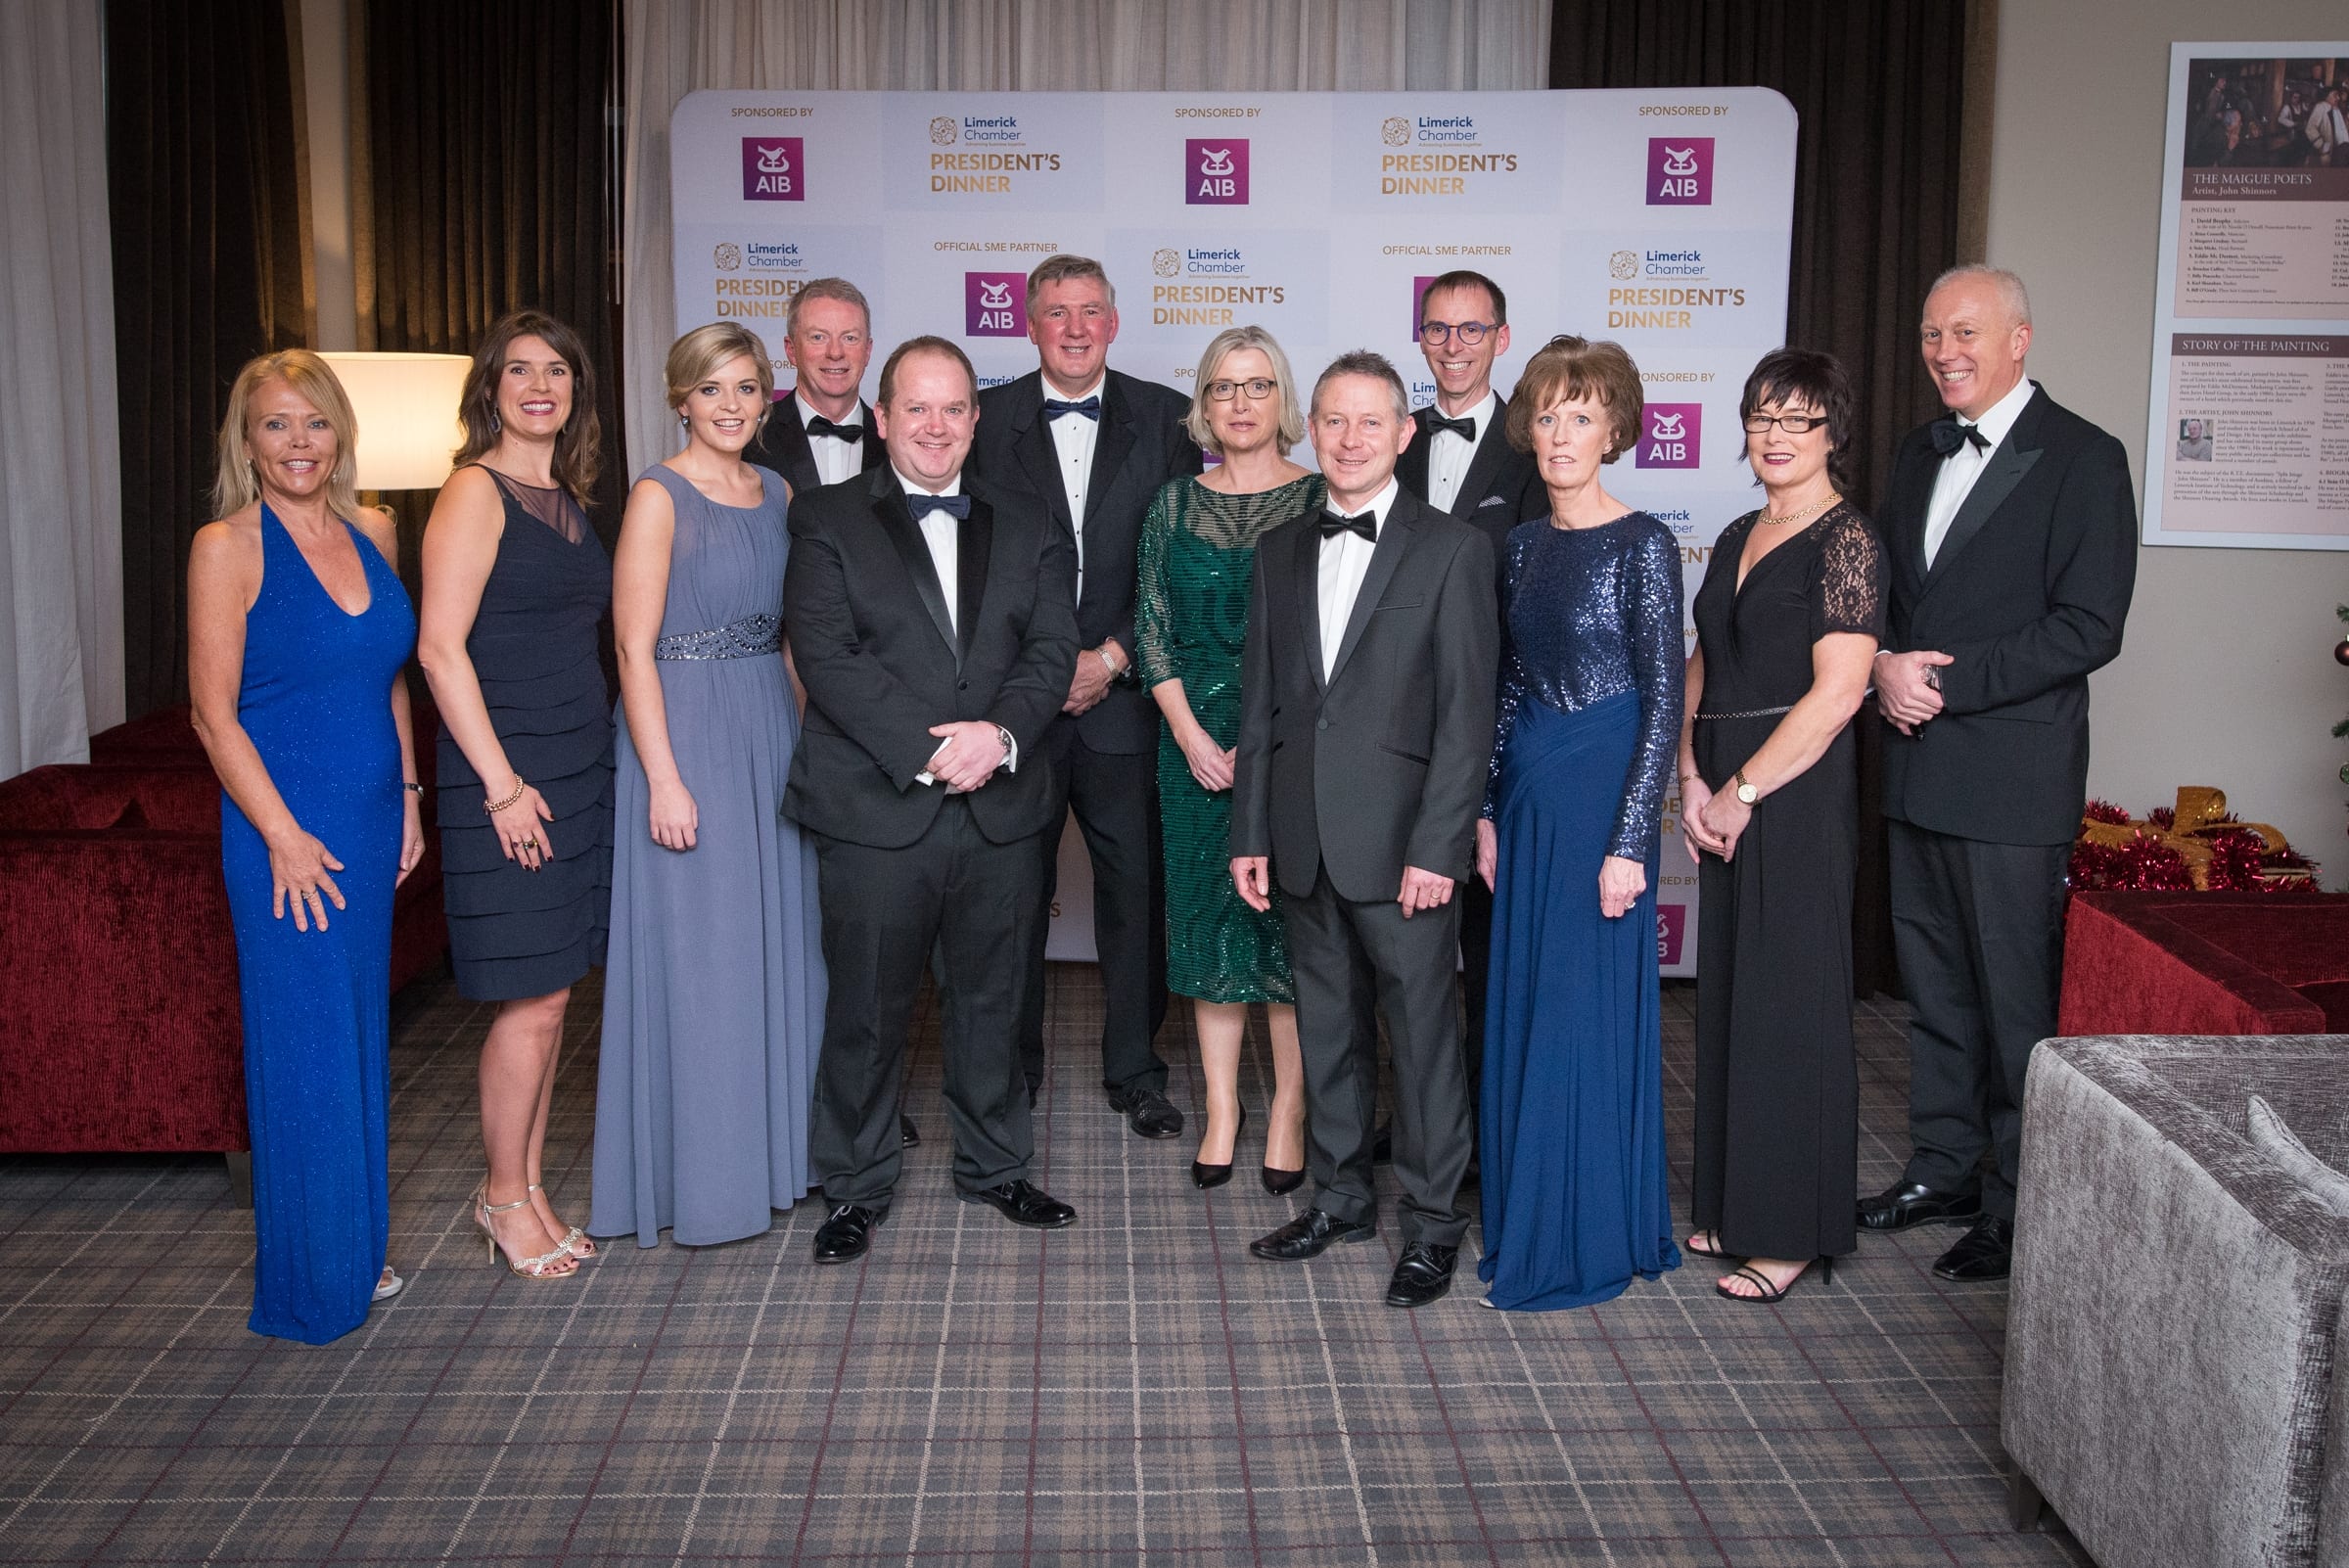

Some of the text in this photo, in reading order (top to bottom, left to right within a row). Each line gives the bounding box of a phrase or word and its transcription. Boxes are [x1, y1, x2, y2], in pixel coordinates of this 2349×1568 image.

[732, 108, 813, 117] SPONSORED BY
[1175, 109, 1261, 118] SPONSORED BY
[1639, 107, 1729, 116] SPONSORED BY
[965, 117, 1017, 128] Limerick
[1419, 116, 1473, 128] Limerick
[964, 129, 1021, 140] Chamber
[1418, 129, 1478, 140] Chamber
[756, 176, 791, 193] AIB
[931, 176, 1010, 192] DINNER
[2193, 174, 2312, 184] THE MAIGUE POETS
[1198, 179, 1236, 196] AIB
[1382, 178, 1465, 194] DINNER
[1659, 179, 1698, 197] AIB
[2218, 186, 2238, 196] John
[748, 243, 798, 254] Limerick
[934, 242, 1058, 253] OFFICIAL SME PARTNER
[1383, 246, 1511, 255] OFFICIAL SME PARTNER
[1188, 249, 1241, 260] Limerick
[1646, 250, 1701, 261] Limerick
[748, 255, 803, 267] Chamber
[1188, 261, 1245, 273] Chamber
[1646, 263, 1705, 275] Chamber
[978, 311, 1013, 329] AIB
[1153, 308, 1233, 324] DINNER
[1608, 311, 1691, 328] DINNER
[2182, 340, 2329, 351] STORY OF THE PAINTING
[1640, 372, 1715, 382] ONSORED BY
[1648, 443, 1686, 461] AIB
[1685, 876, 1699, 885] BY
